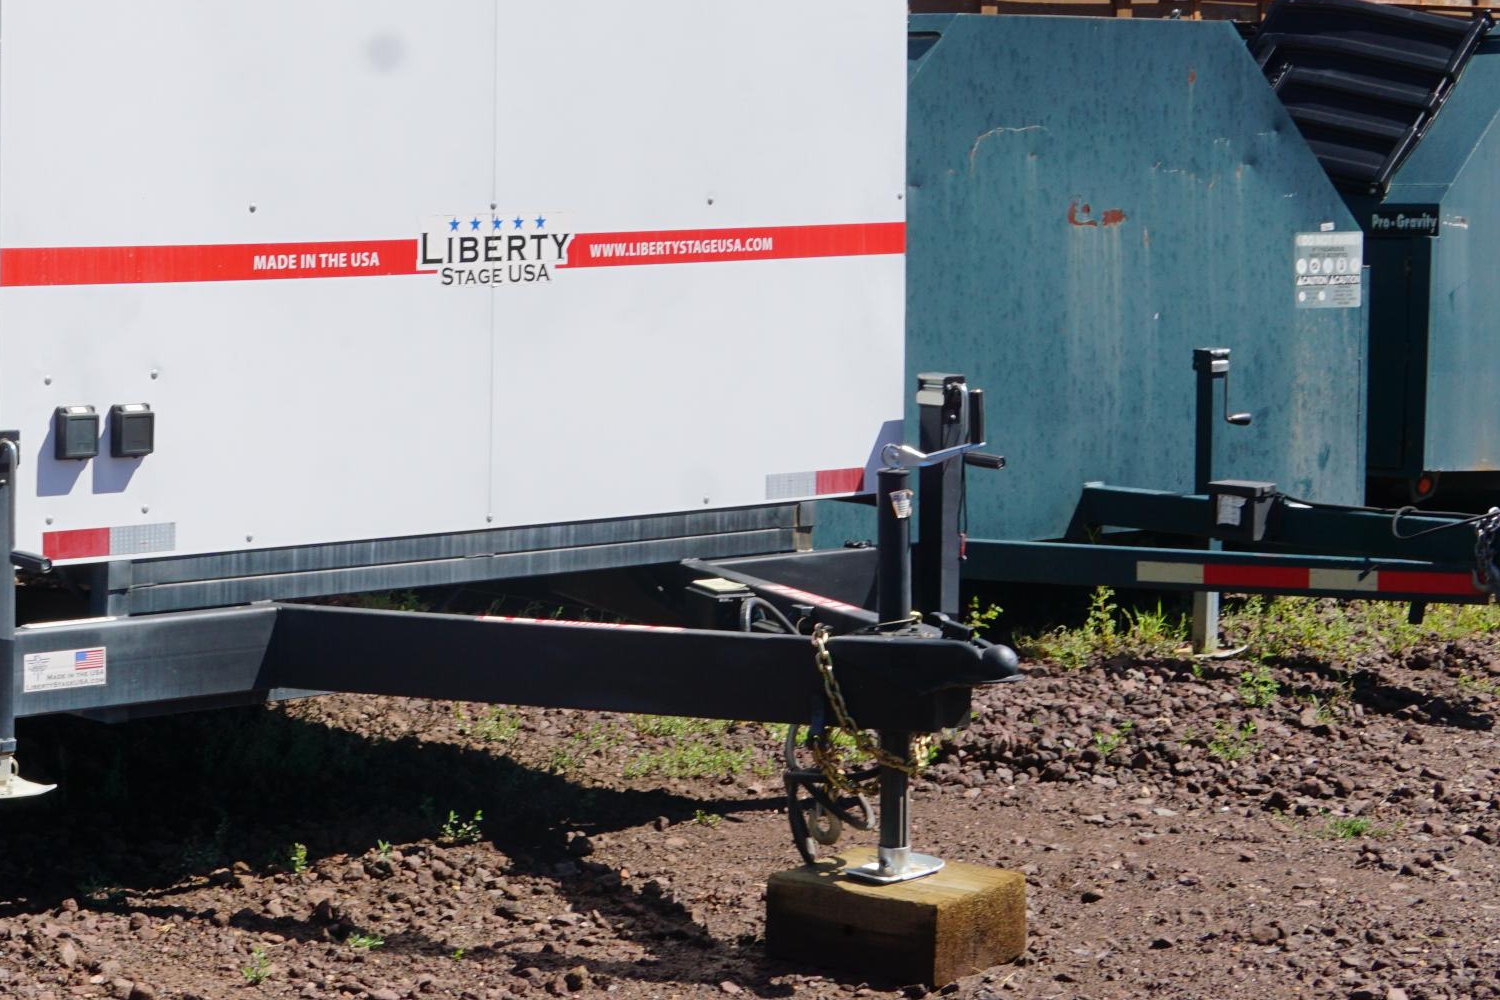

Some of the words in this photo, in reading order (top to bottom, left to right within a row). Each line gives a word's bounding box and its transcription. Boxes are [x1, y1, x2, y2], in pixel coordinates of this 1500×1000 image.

[421, 232, 570, 265] LIBERTY
[589, 237, 773, 258] WWW.LIBERTYSTAGEUSA.COM
[253, 254, 297, 270] MADE
[300, 253, 317, 269] IN
[319, 252, 348, 268] THE
[350, 250, 380, 267] USA
[441, 267, 502, 286] STAGE
[508, 264, 551, 283] USA
